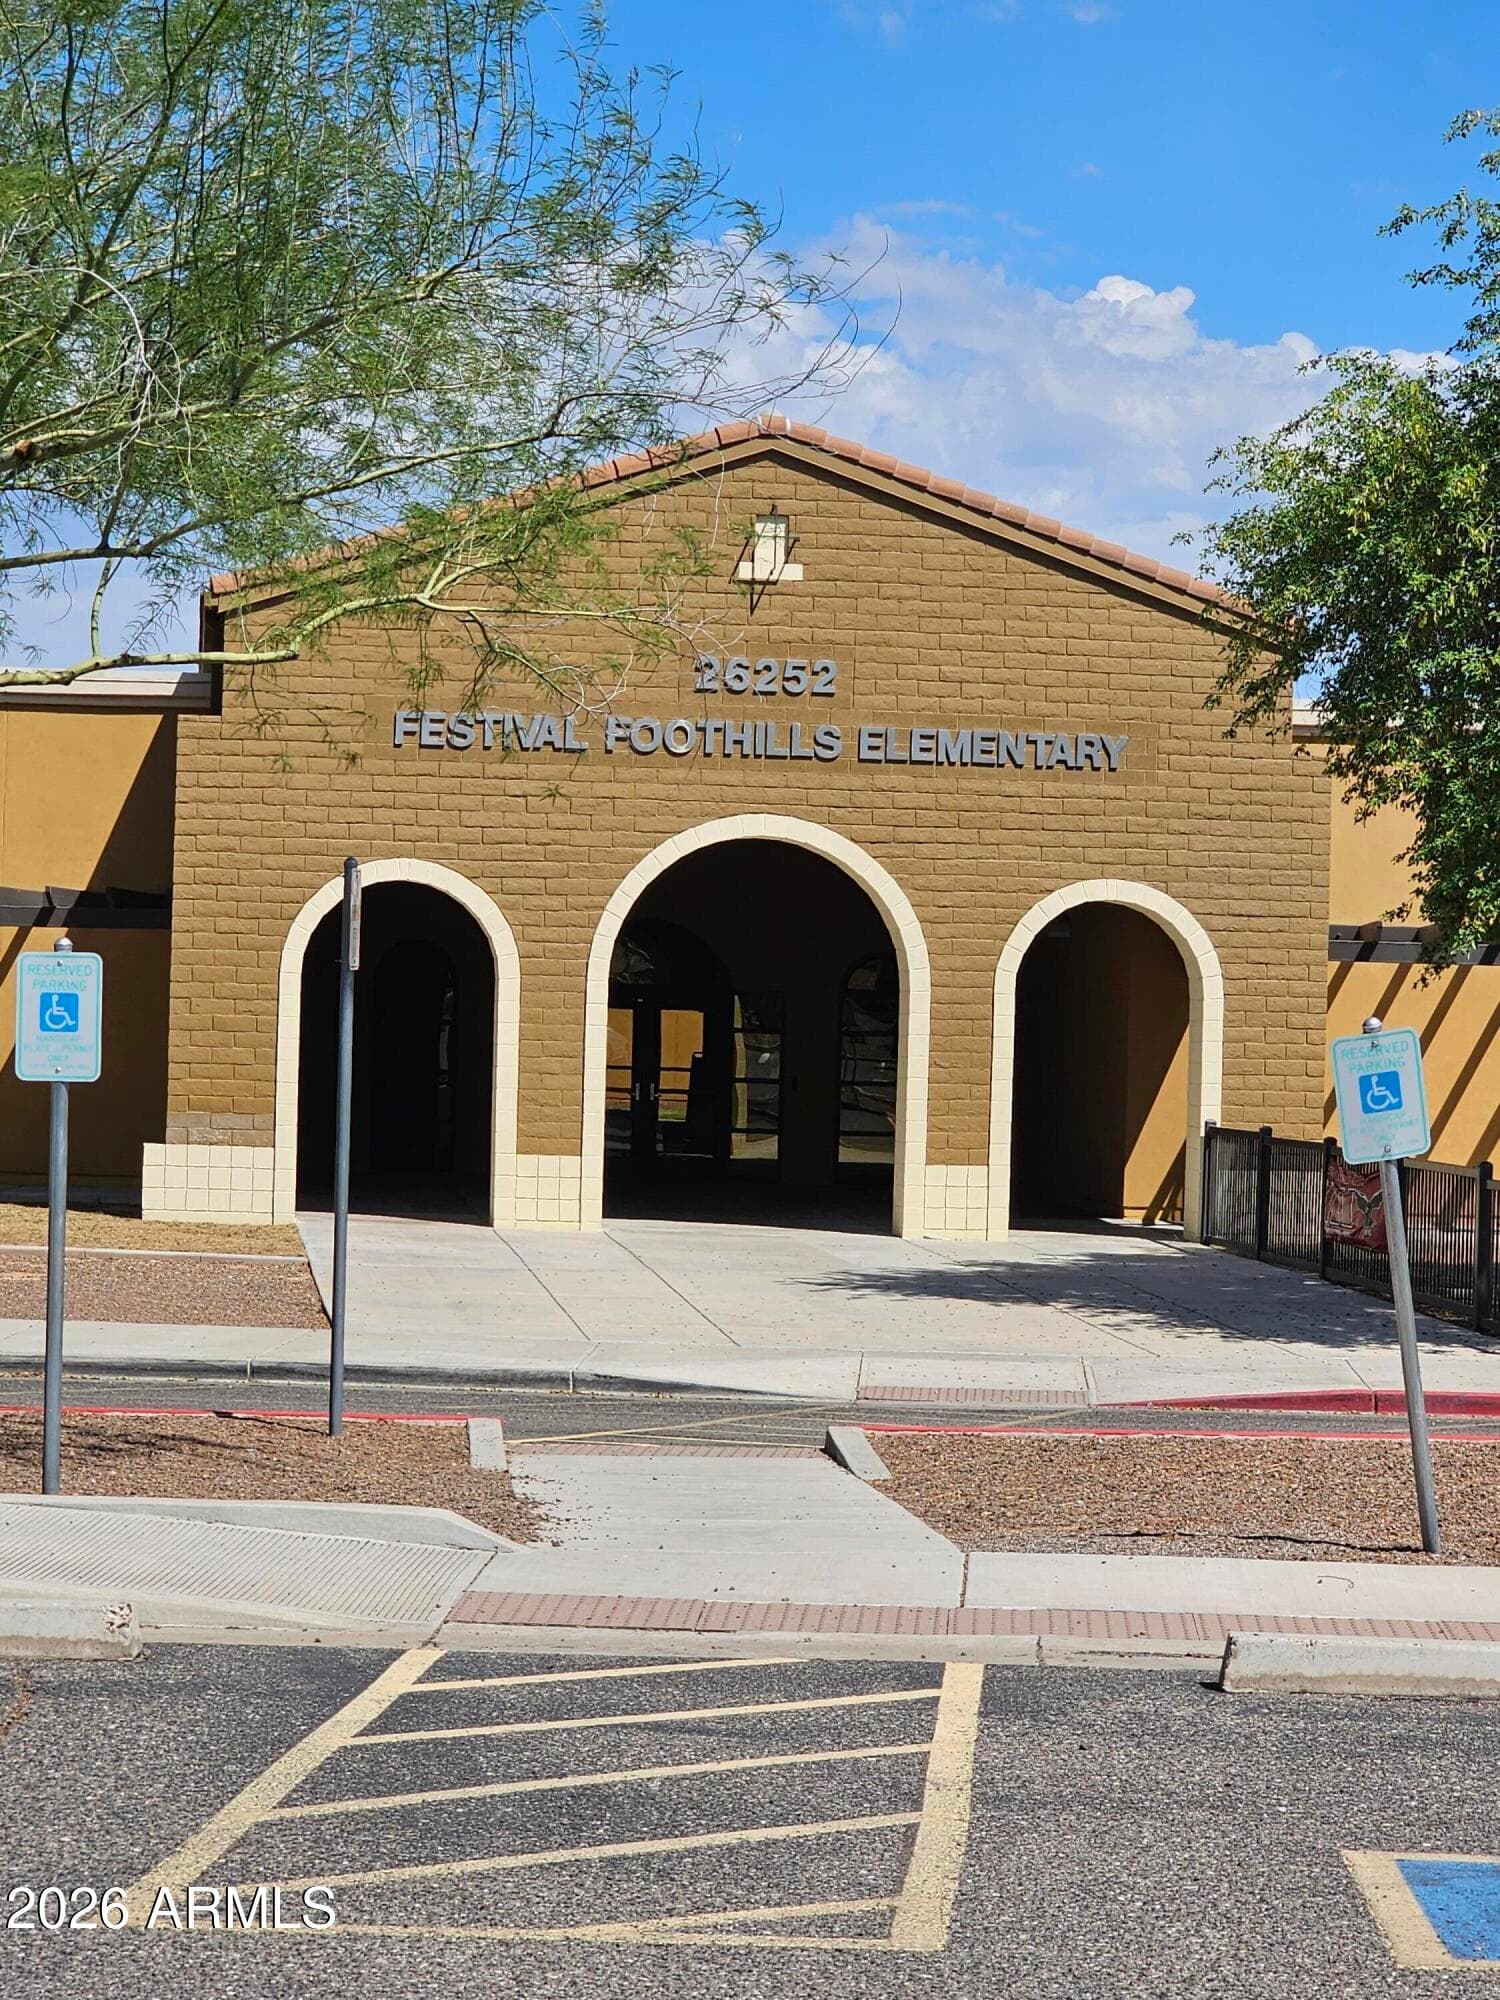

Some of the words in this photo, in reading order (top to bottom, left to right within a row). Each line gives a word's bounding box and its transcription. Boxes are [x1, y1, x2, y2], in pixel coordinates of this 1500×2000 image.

[696, 656, 838, 696] 26252
[394, 711, 588, 752] FESTIVAL
[605, 715, 841, 761] FOOTHILLS
[858, 726, 1129, 772] ELEMENTARY
[27, 963, 93, 976] RESERVED
[32, 978, 88, 992] PARKING
[1341, 1040, 1409, 1060] RESERVED
[1348, 1056, 1406, 1073] PARKING
